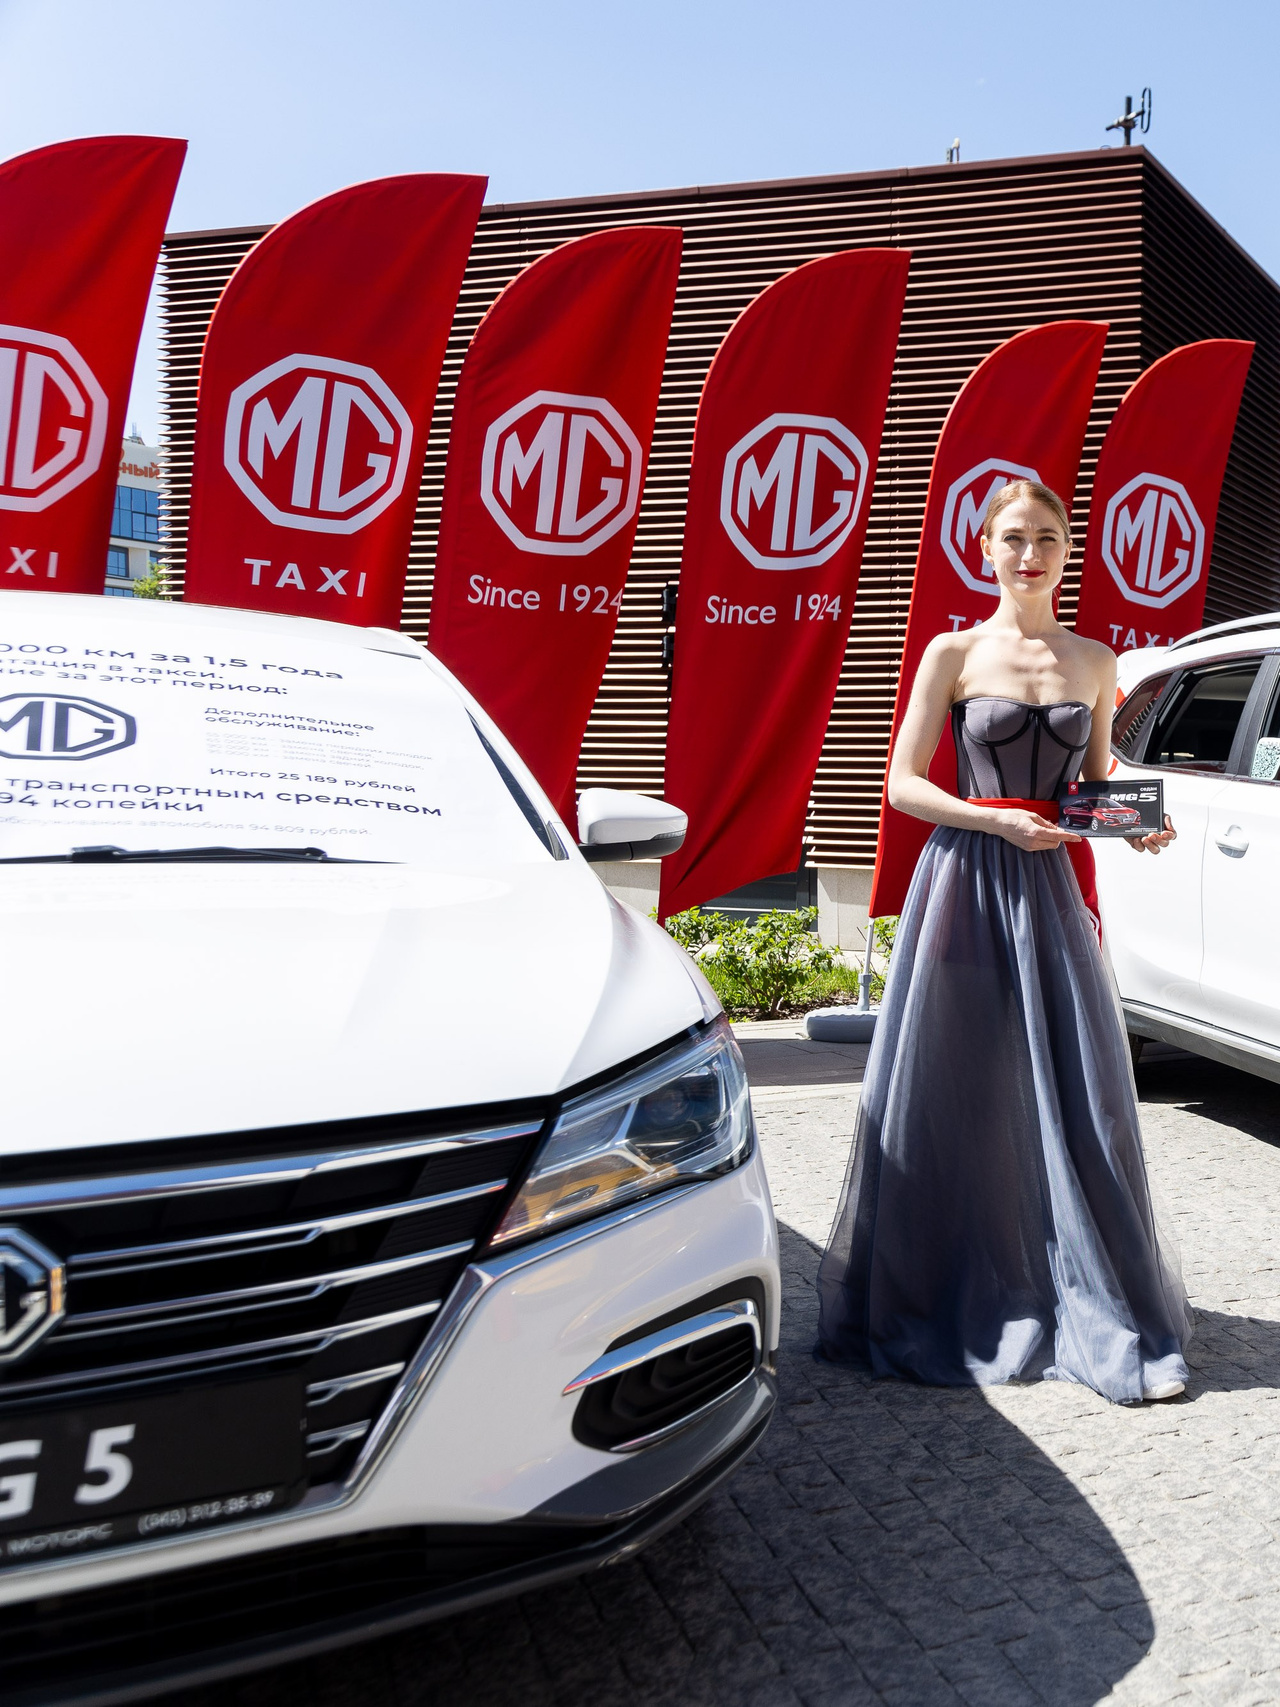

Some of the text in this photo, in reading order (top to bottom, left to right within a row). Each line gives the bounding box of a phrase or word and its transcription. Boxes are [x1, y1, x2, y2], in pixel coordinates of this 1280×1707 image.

[247, 376, 395, 513] MG
[498, 411, 625, 536] MG
[737, 432, 856, 552] MG
[1117, 489, 1192, 587] MG
[244, 557, 367, 598] TAXI
[467, 573, 622, 615] Since 1924
[704, 593, 842, 625] Since 1924
[0, 658, 96, 670] тация
[134, 667, 224, 679] такси.
[0, 668, 289, 695] ие за этот период:
[84, 648, 135, 659] км
[150, 653, 191, 664] за
[203, 656, 248, 668] 1,5
[261, 663, 343, 680] года
[0, 701, 115, 752] MG
[204, 707, 375, 731] Дополнительное
[205, 716, 361, 737] обслуживание:
[6, 778, 442, 817] транспортным средством
[210, 768, 416, 794] Итого 25 189 рублей
[0, 791, 204, 812] 94 копейки
[74, 1423, 136, 1506] 5
